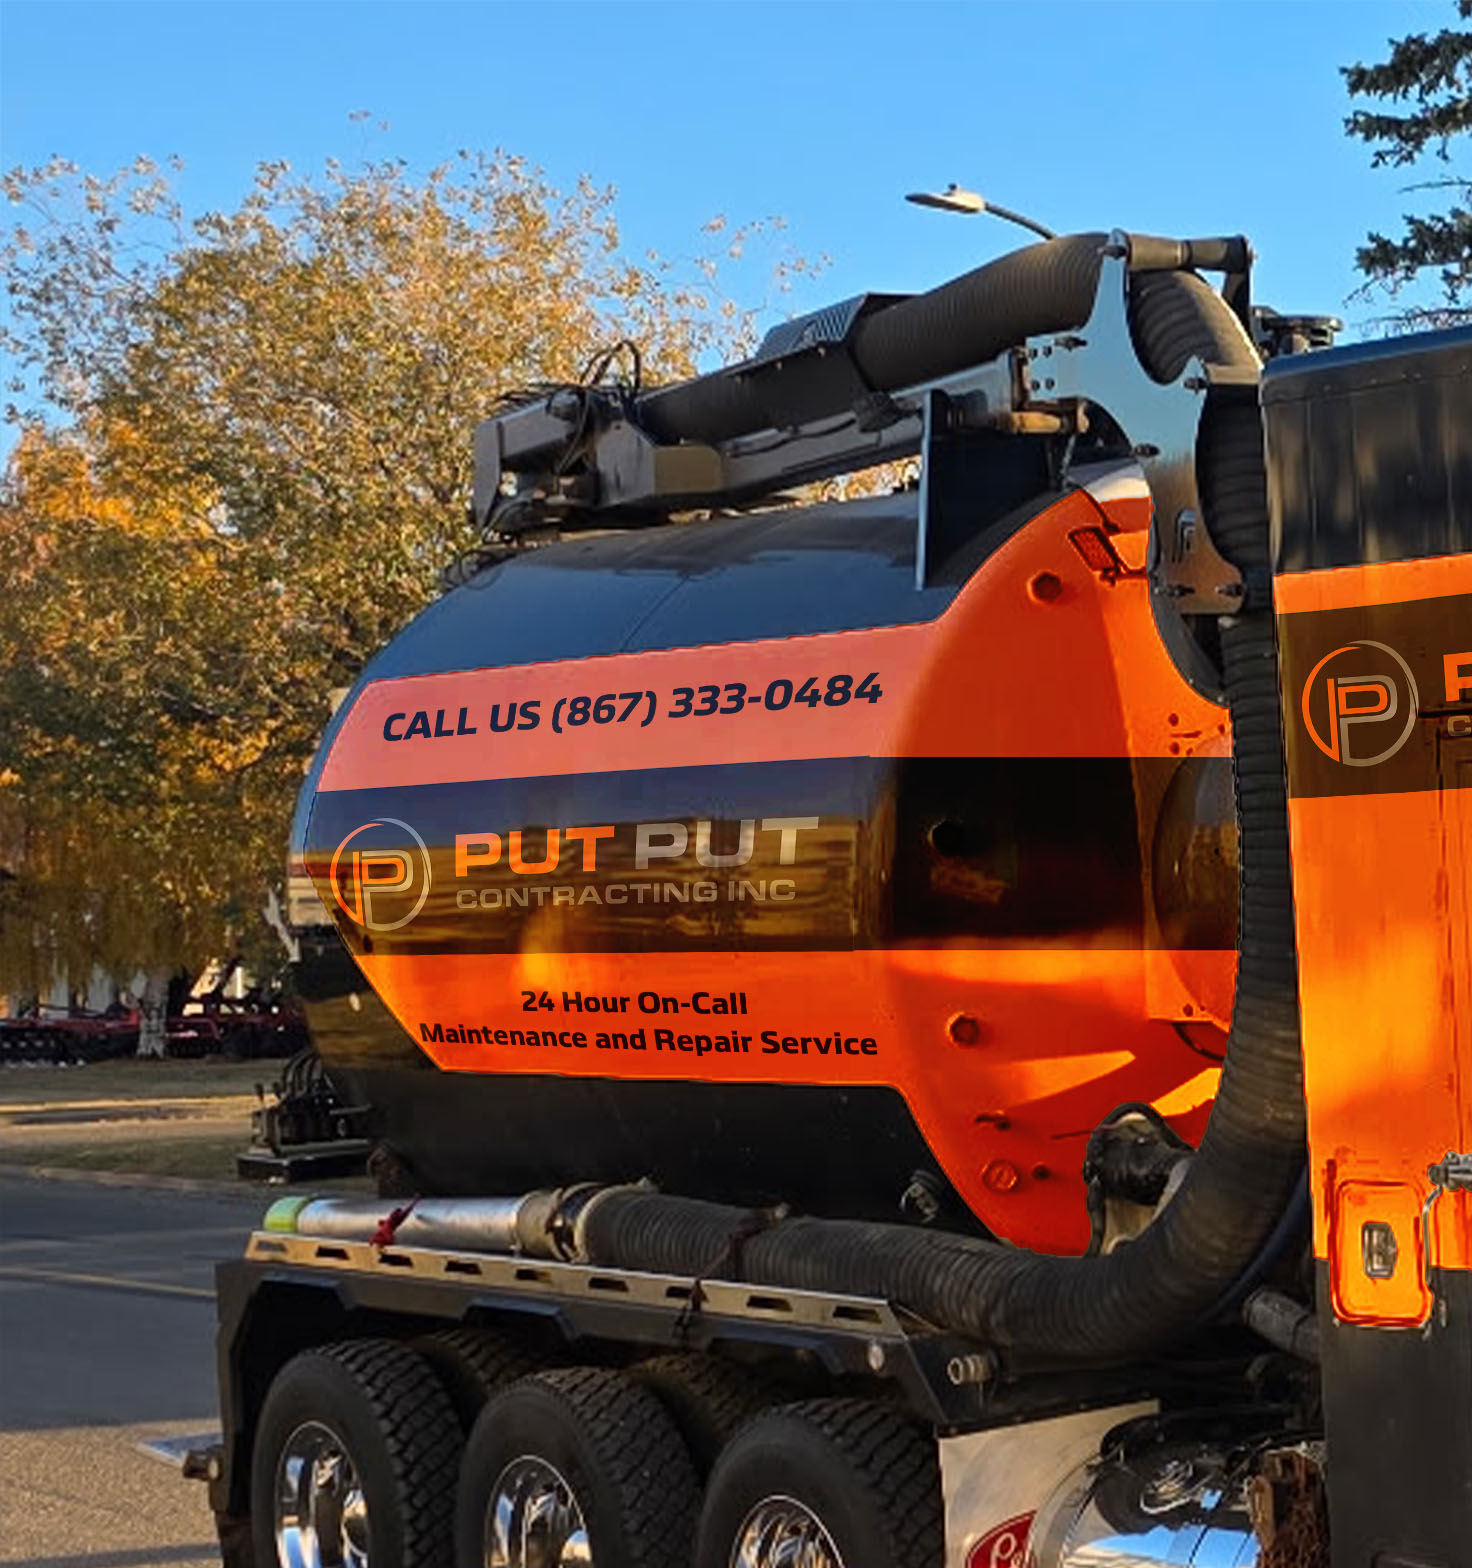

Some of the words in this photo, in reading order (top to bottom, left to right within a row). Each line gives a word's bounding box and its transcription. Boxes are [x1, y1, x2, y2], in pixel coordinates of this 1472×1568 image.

[383, 707, 476, 742] CALL
[489, 700, 541, 734] US
[551, 690, 657, 734] (867)
[669, 672, 884, 719] 333-0484
[455, 826, 614, 877] PUT
[635, 816, 819, 870] PUT
[455, 880, 718, 910] CONTRACTING
[728, 879, 796, 902] INC
[521, 990, 555, 1013] 24
[562, 991, 630, 1014] Hour
[638, 992, 748, 1015] On-Call
[419, 1022, 588, 1050] Maintenance
[595, 1028, 648, 1052] and
[655, 1029, 753, 1057] Repair
[761, 1030, 878, 1056] Service
